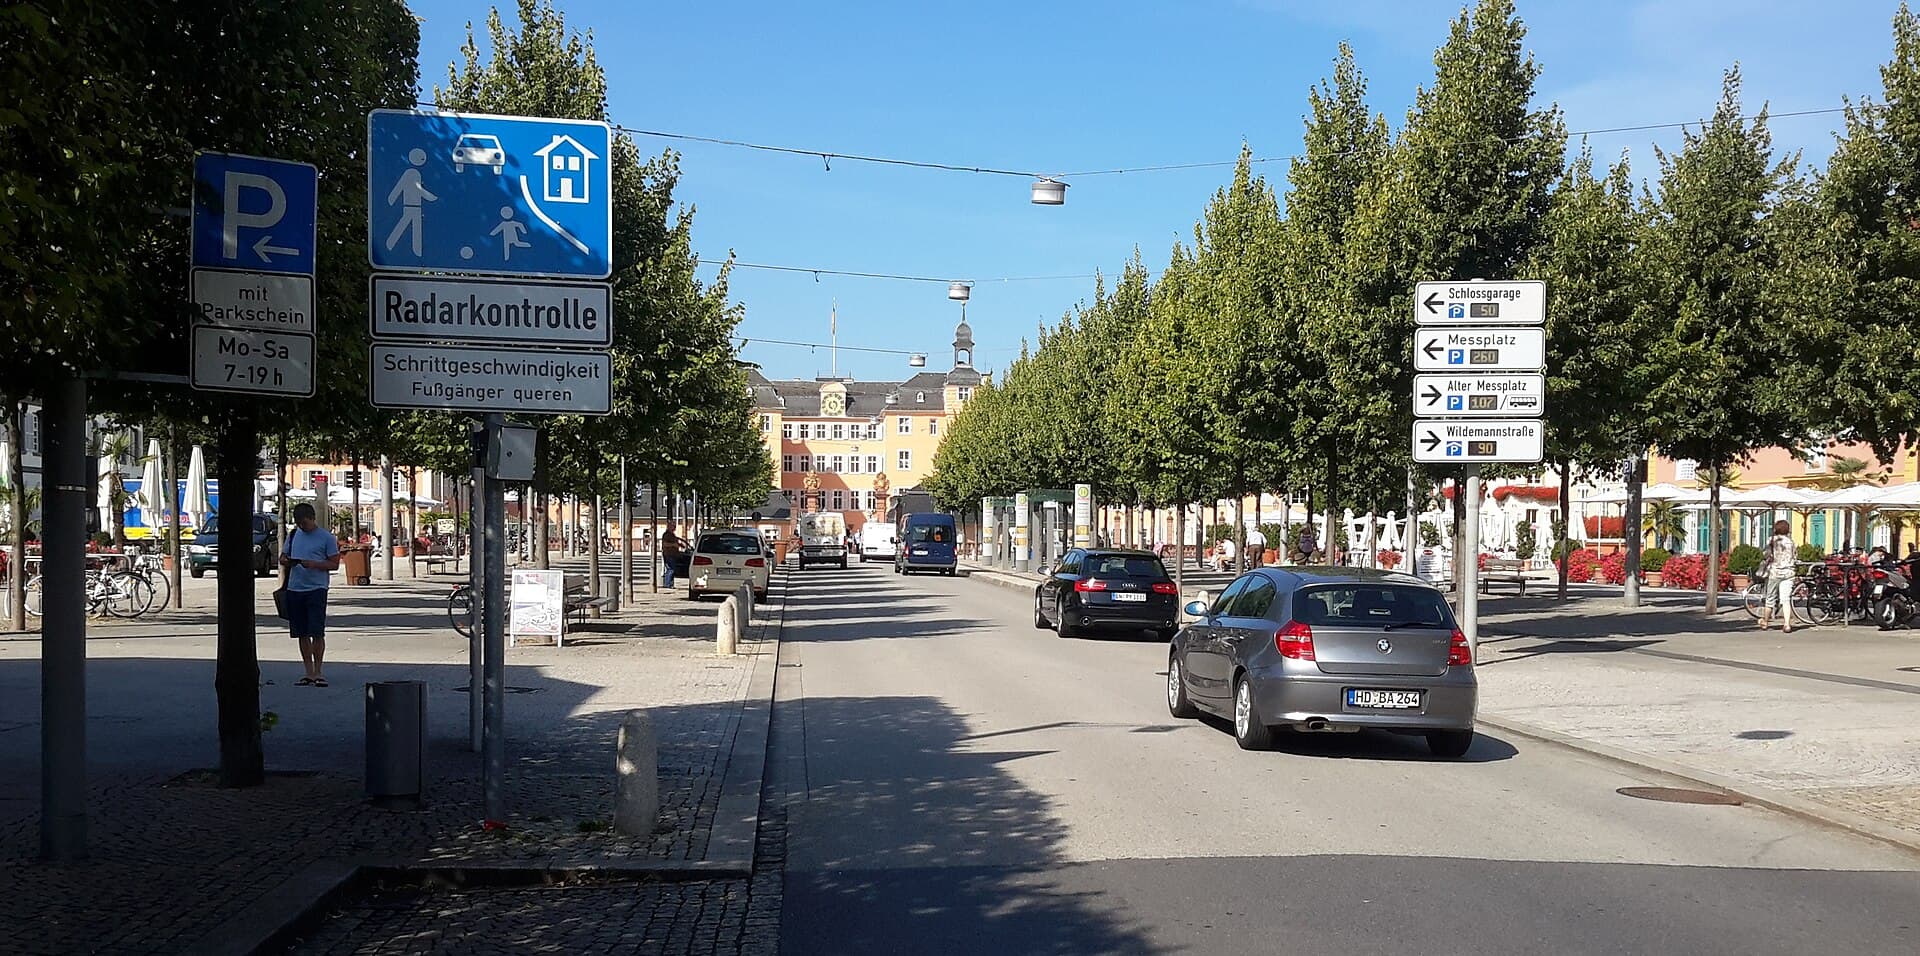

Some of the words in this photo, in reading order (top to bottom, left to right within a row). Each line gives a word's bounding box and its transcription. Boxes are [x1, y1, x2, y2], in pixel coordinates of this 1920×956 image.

[222, 170, 287, 260] P
[238, 286, 269, 301] mit
[1448, 287, 1521, 301] Schlossgarage
[202, 302, 304, 324] Parkschein
[385, 290, 597, 330] Radarkontrolle
[1452, 307, 1461, 318] P
[1480, 304, 1496, 316] 50
[218, 336, 290, 360] Mo-Sa
[1448, 334, 1516, 348] Messplatz
[1451, 351, 1461, 363] P
[1473, 351, 1496, 362] 260
[383, 354, 600, 381] Schrittgeschwindigkeit
[224, 364, 268, 385] 7-19
[273, 367, 283, 386] h
[412, 381, 504, 401] Fußgänger
[513, 387, 572, 402] queren
[1447, 380, 1471, 391] Alter
[1477, 380, 1527, 394] Messplatz
[1450, 397, 1459, 409] P
[1471, 397, 1494, 409] 107
[1446, 426, 1534, 437] Wildemannstraße
[1450, 446, 1459, 456] P
[1478, 443, 1493, 454] 90
[1355, 691, 1371, 703] HD
[1379, 691, 1394, 704] BA
[1397, 692, 1418, 705] 264
